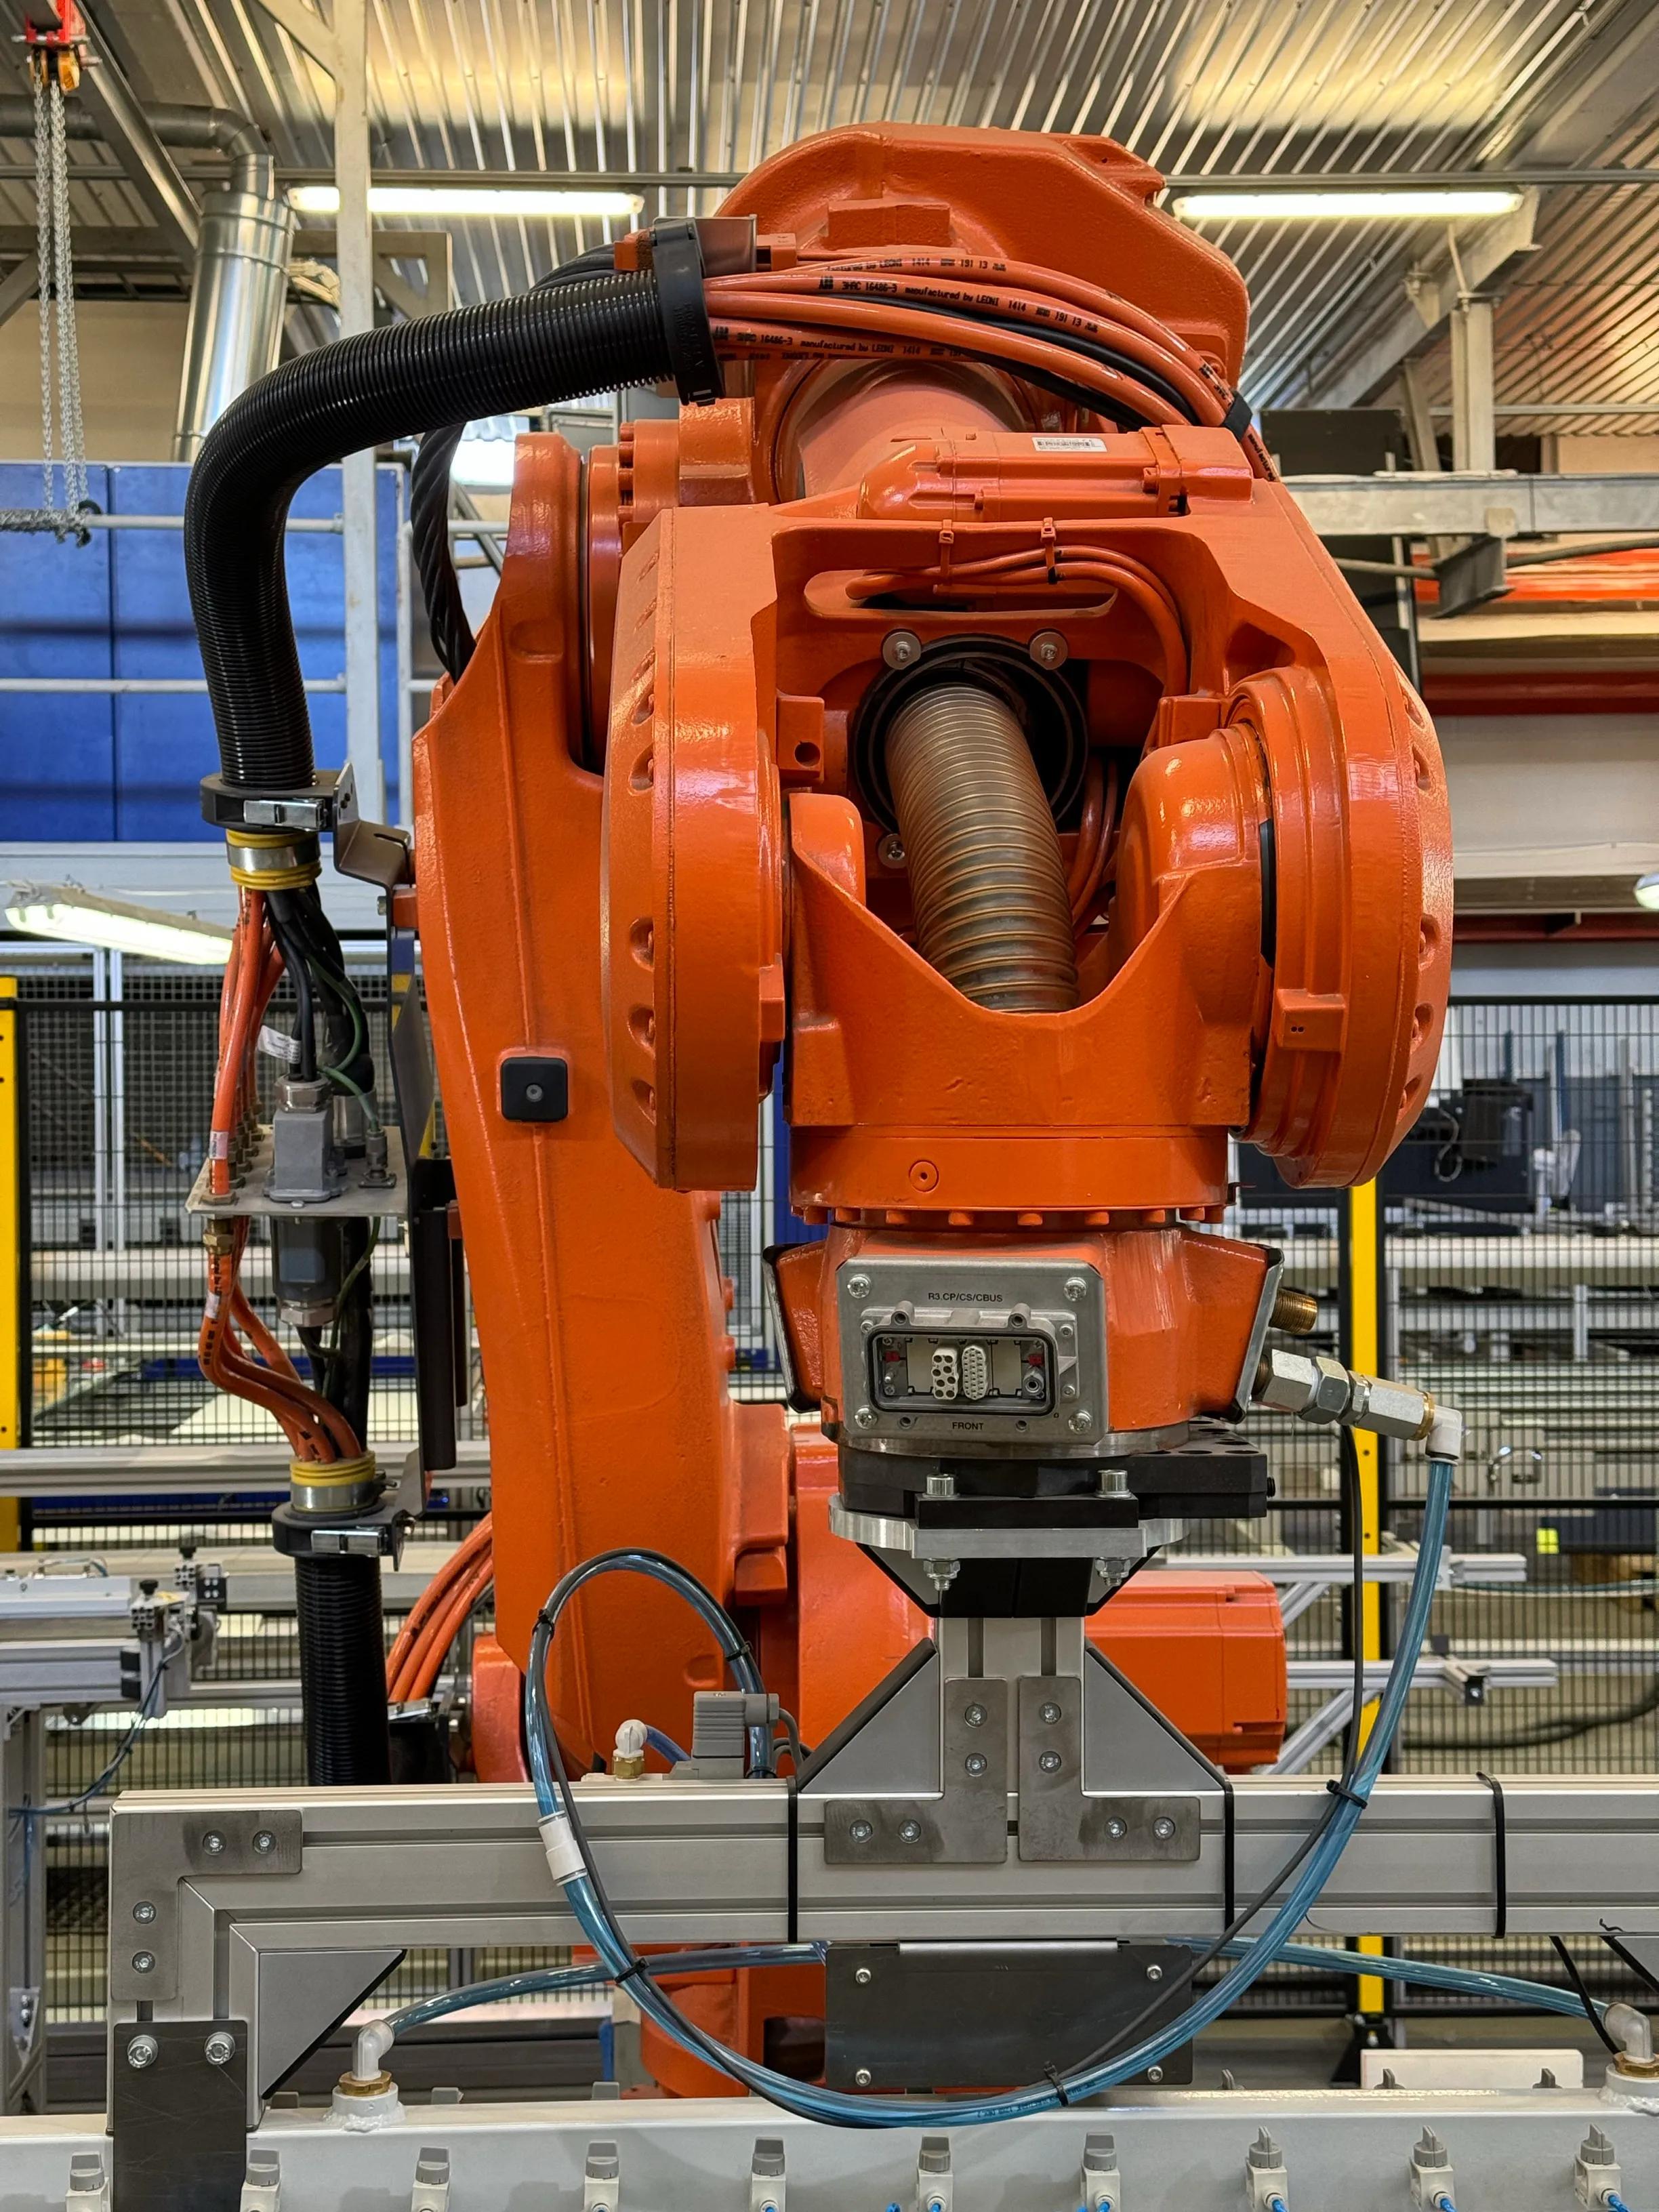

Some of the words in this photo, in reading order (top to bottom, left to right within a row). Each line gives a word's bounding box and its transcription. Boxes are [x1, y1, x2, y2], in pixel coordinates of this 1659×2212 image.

[960, 259, 973, 268] 191
[979, 260, 988, 269] 13
[905, 287, 960, 301] manufactured
[963, 293, 973, 302] by
[976, 294, 1000, 306] LEONI
[1008, 301, 1026, 312] 1414
[1054, 312, 1068, 323] 191
[1072, 316, 1082, 327] 13
[800, 340, 855, 352] manufactured
[859, 343, 869, 352] by
[928, 1292, 1003, 1303] R3.CP/CS/CBUS
[951, 1422, 983, 1431] FRONT
